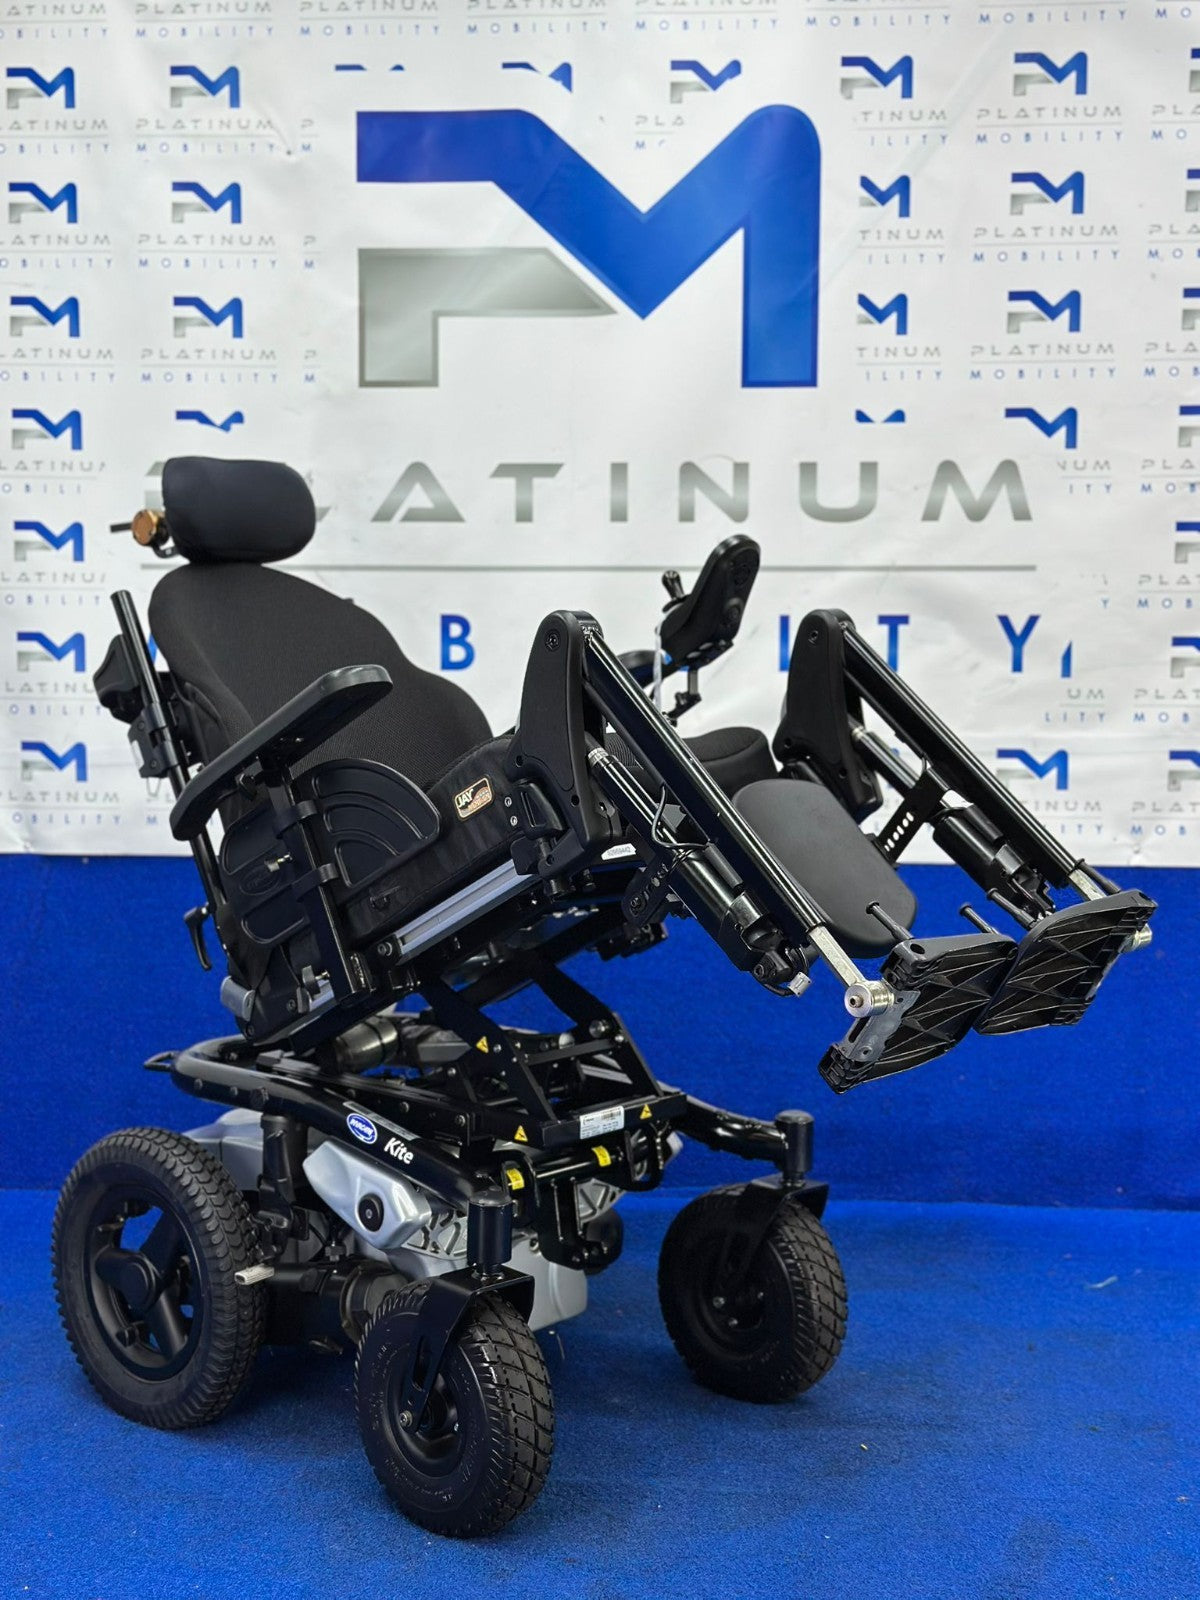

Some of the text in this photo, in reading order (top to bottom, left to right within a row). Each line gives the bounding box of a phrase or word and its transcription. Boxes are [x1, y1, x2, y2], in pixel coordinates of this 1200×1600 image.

[135, 2, 272, 14] PLATINUM
[299, 0, 439, 12] PLATINUM
[805, 15, 951, 27] MOBILITY
[978, 10, 1127, 23] MOBILITY
[299, 24, 439, 36] MOBILITY
[466, 22, 608, 34] MOBILITY
[635, 19, 778, 31] MOBILITY
[135, 26, 273, 38] MOBILITY
[976, 106, 1122, 119] PLATINUM
[0, 119, 108, 131] ATINUM
[135, 118, 274, 130] PLATINUM
[975, 131, 1123, 144] MOBILITY
[136, 142, 276, 154] MOBILITY
[973, 225, 1118, 238] PLATINUM
[0, 234, 111, 246] ATINUM
[137, 234, 276, 246] PLATINUM
[973, 250, 1120, 262] MOBILITY
[138, 257, 277, 269] MOBILITY
[141, 348, 276, 360] PLATINUM
[971, 343, 1115, 356] PLATINUM
[141, 372, 278, 384] MOBILITY
[969, 368, 1116, 380] MOBILITY
[457, 789, 473, 807] JAY
[384, 1137, 414, 1164] Kite
